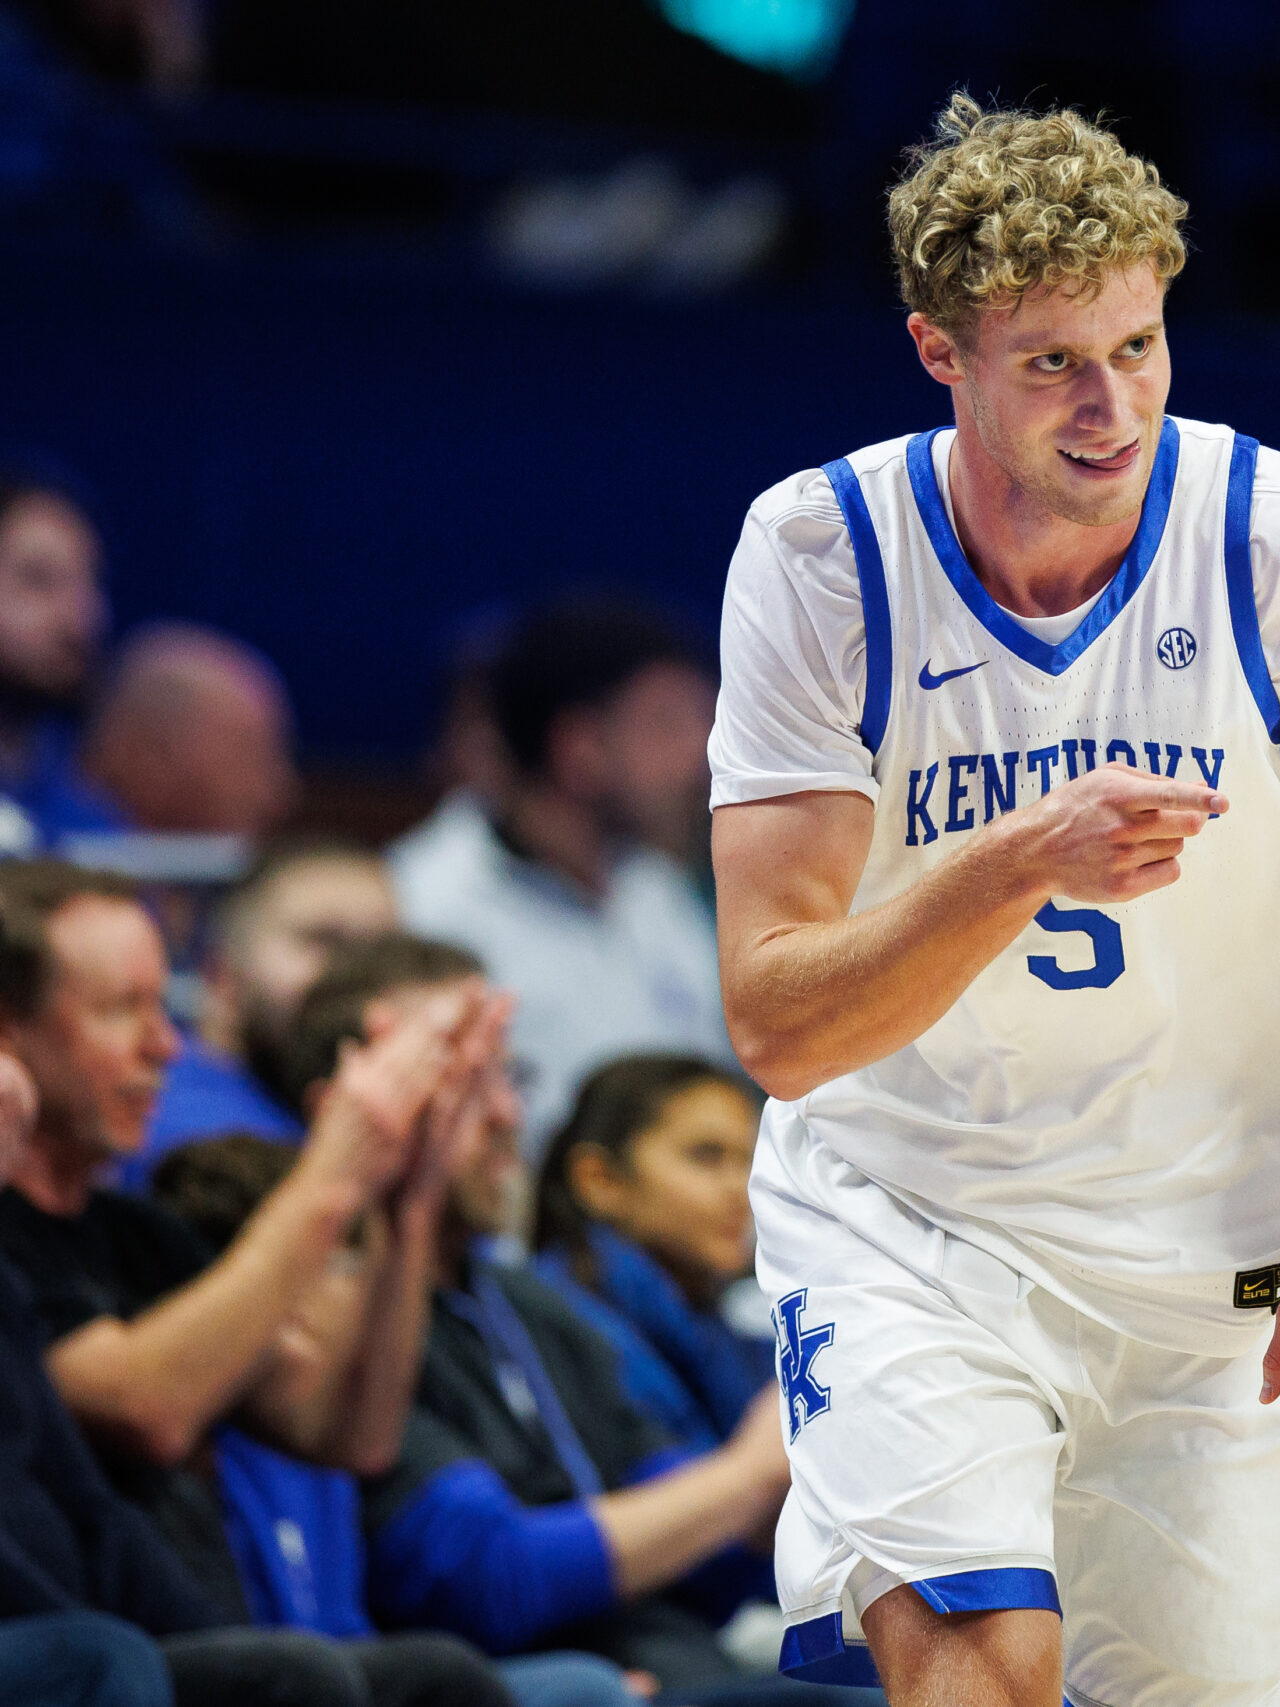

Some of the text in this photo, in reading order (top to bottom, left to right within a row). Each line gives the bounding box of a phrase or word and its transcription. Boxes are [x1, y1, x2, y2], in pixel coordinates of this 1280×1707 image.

[1159, 630, 1195, 667] SEC
[1026, 898, 1126, 991] 5
[1243, 1288, 1270, 1299] ELITE
